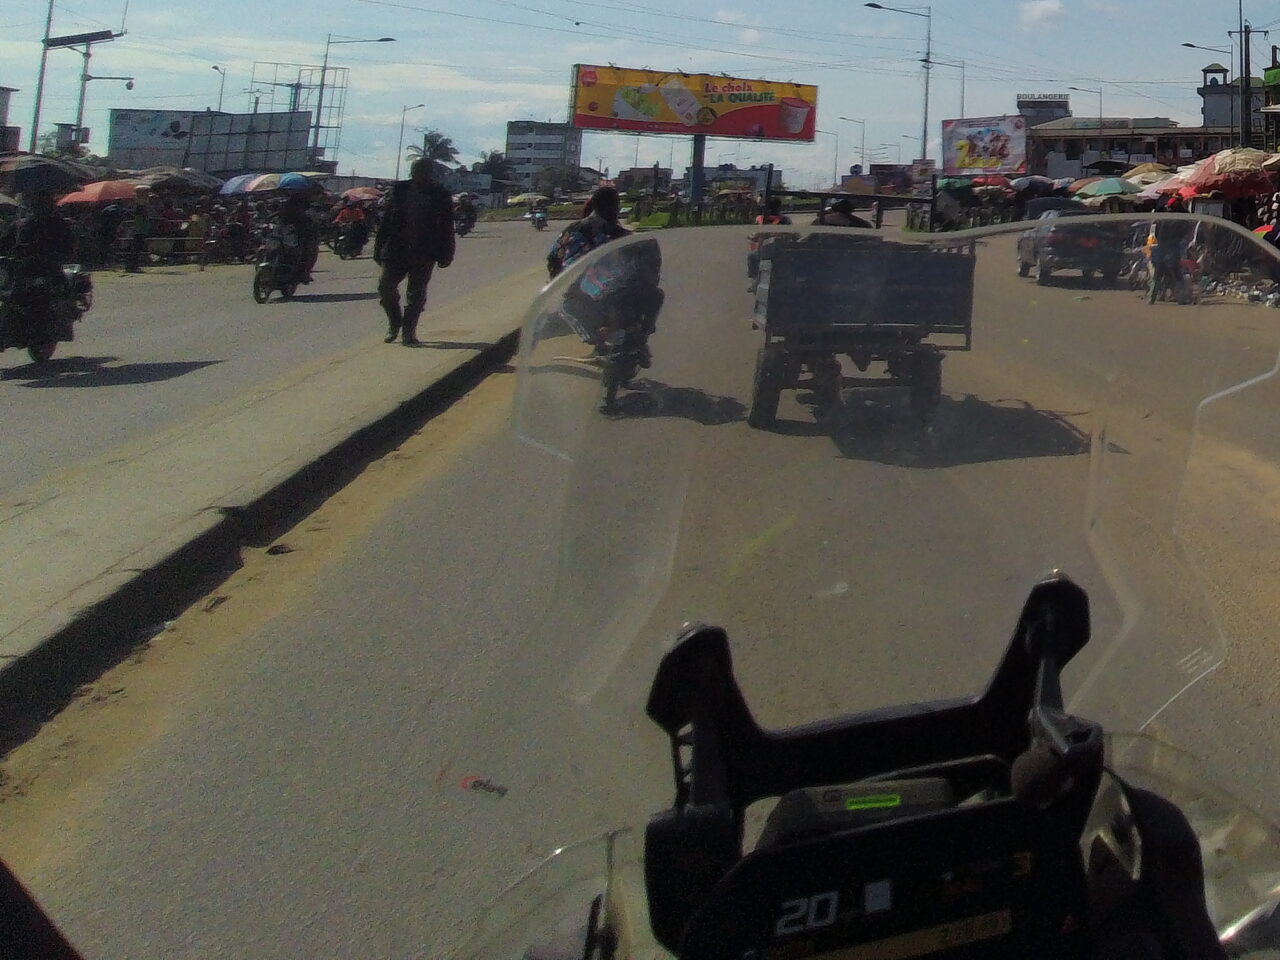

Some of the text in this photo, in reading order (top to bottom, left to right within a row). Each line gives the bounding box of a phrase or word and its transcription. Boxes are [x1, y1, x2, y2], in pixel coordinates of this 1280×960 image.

[704, 81, 753, 93] Le choix
[775, 890, 840, 937] 20
